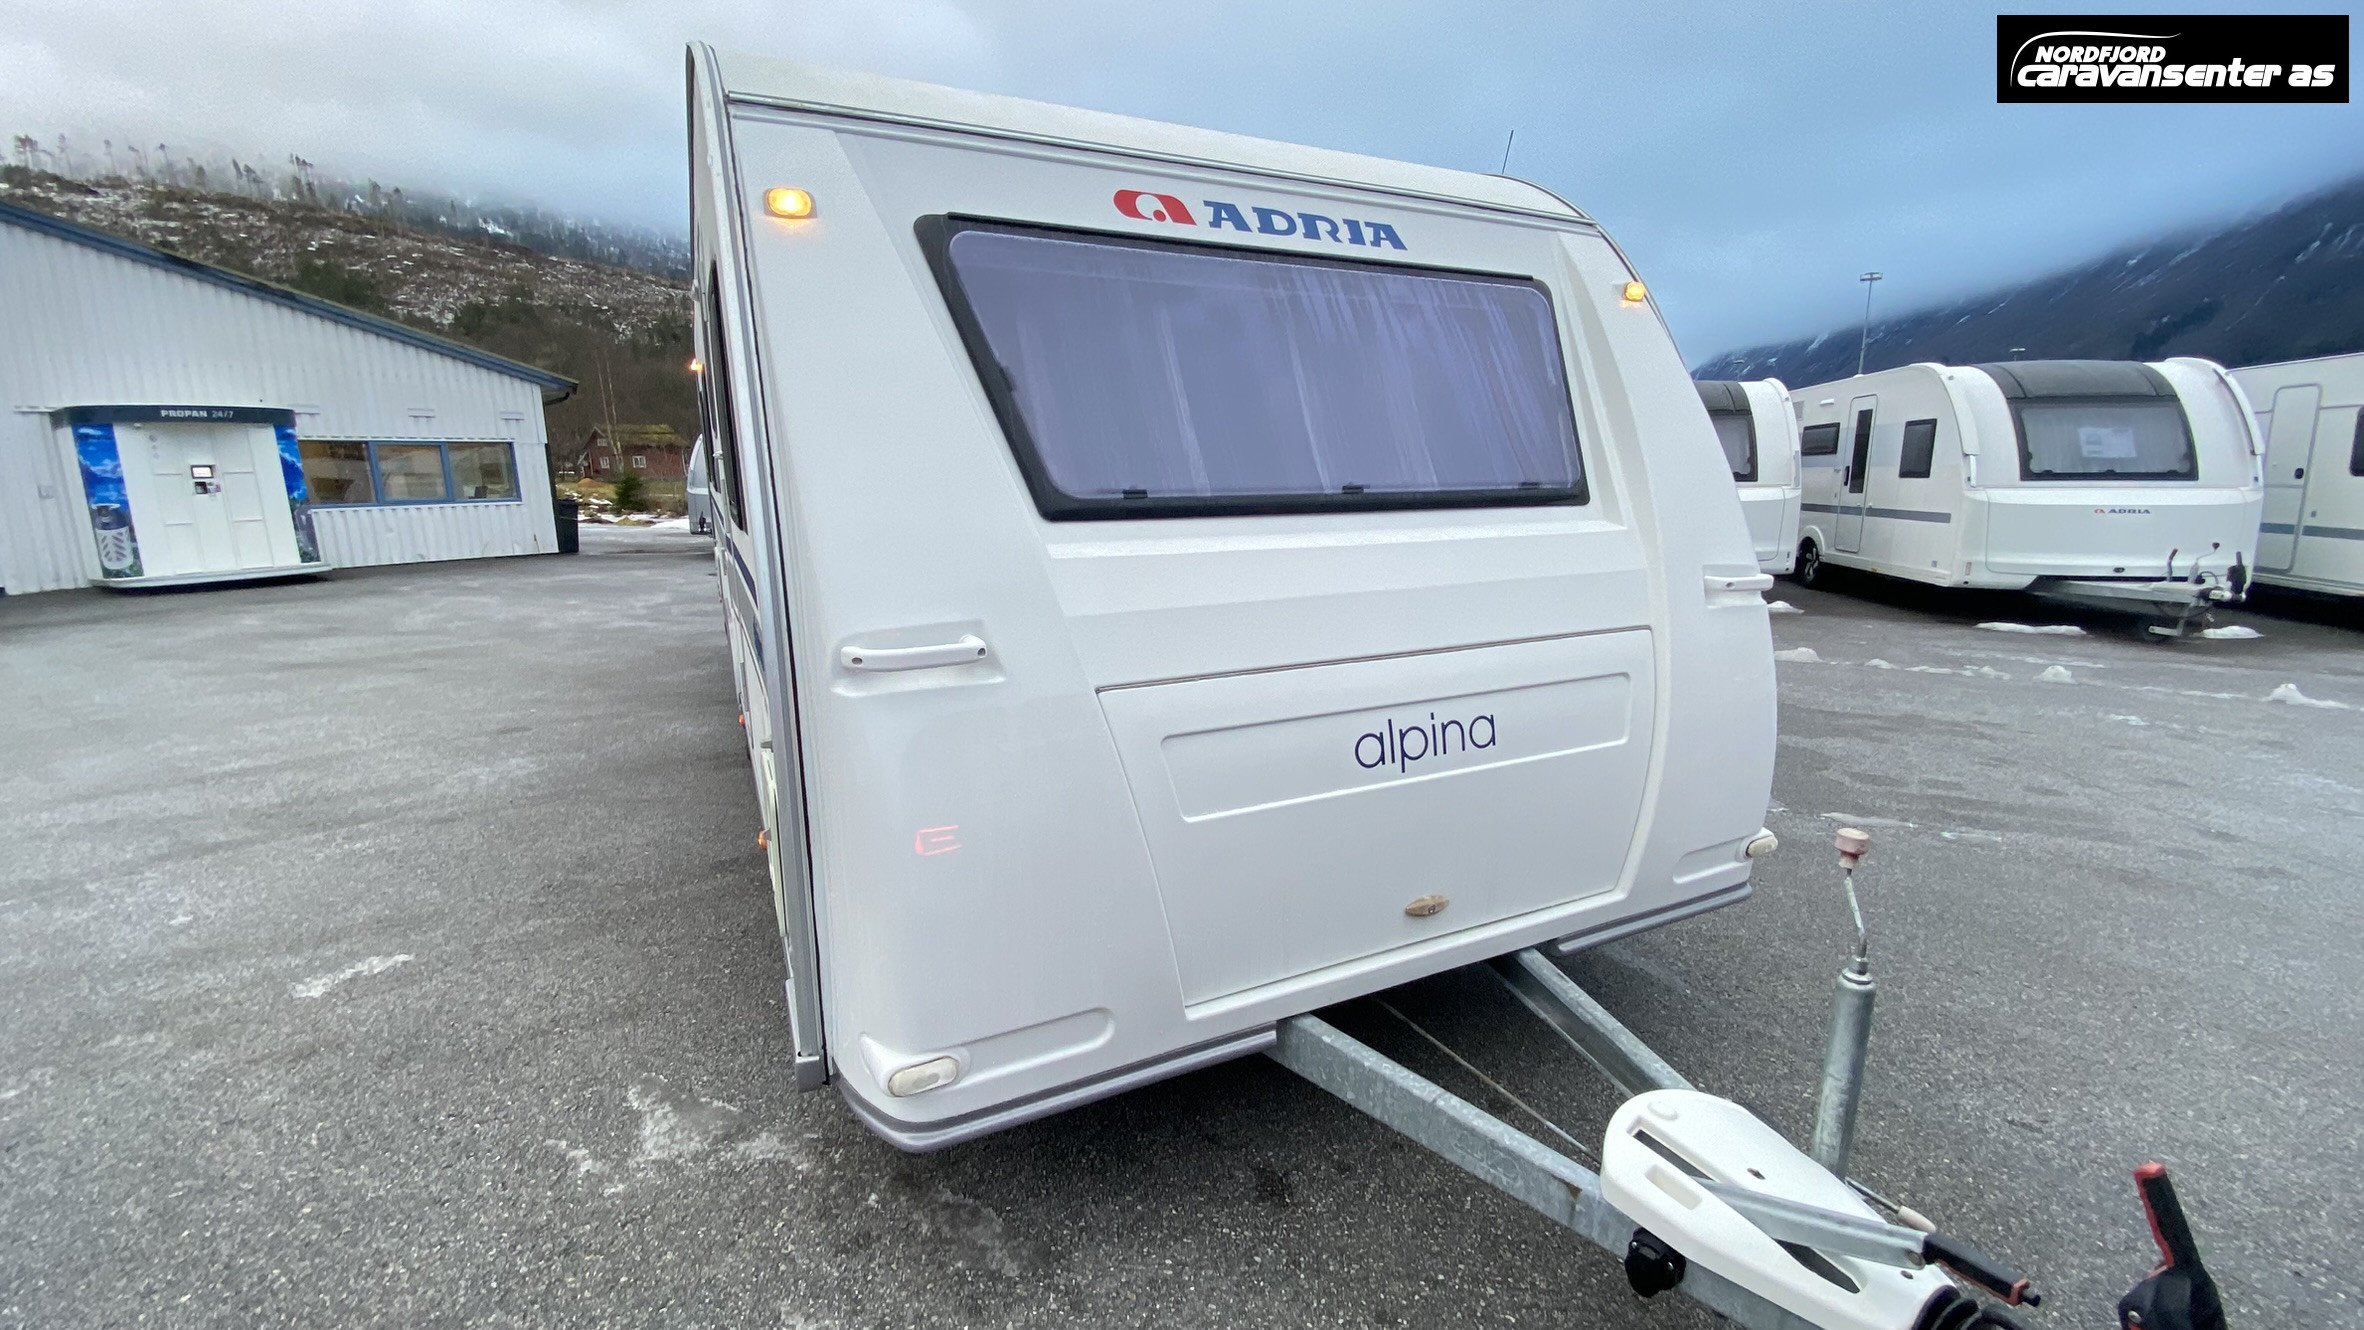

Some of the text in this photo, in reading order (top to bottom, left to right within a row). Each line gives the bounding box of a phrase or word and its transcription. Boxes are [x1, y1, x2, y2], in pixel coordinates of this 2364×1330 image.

[1202, 199, 1409, 251] ADRIA
[160, 409, 235, 419] PROPAN 24/7
[1354, 711, 1497, 774] alpina
